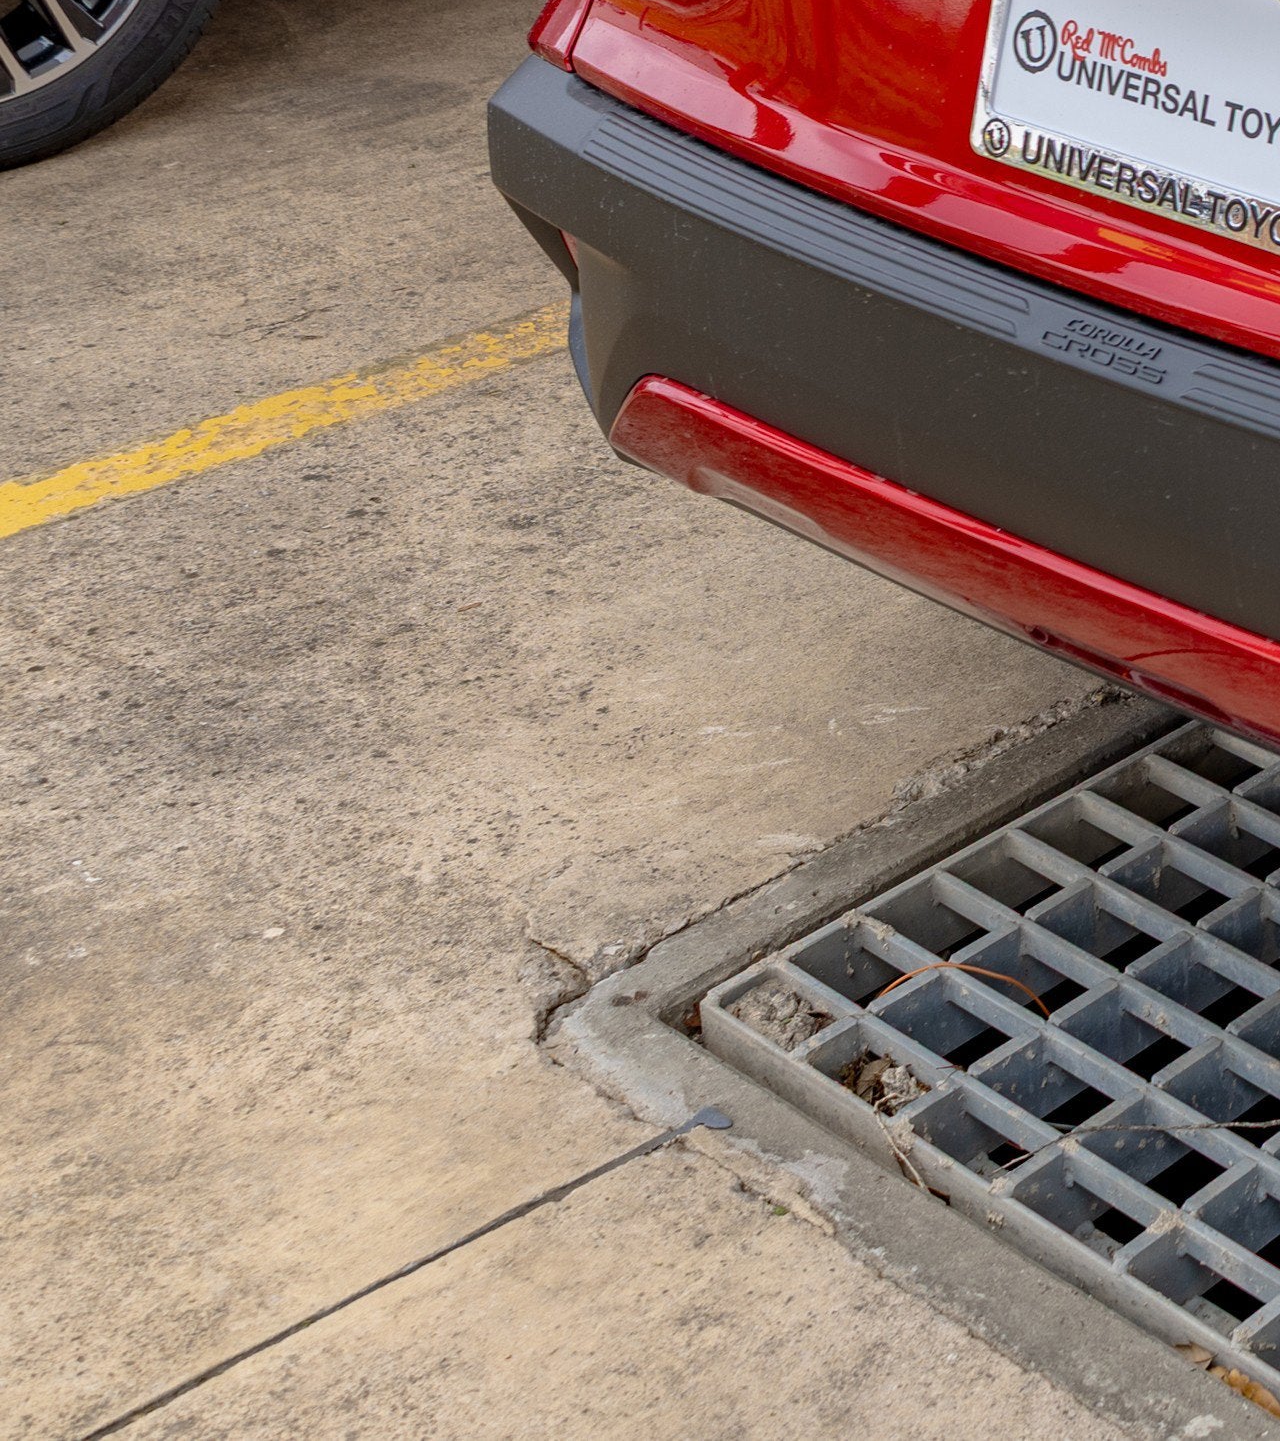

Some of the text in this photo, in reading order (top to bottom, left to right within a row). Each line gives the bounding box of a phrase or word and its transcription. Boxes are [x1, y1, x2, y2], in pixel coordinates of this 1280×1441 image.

[1061, 20, 1168, 77] Red McCombs
[1057, 51, 1216, 127] UNIVERSAL
[1021, 130, 1201, 218] UNIVERSAL
[1040, 331, 1167, 385] CROSS
[1064, 318, 1162, 361] COROLLA
